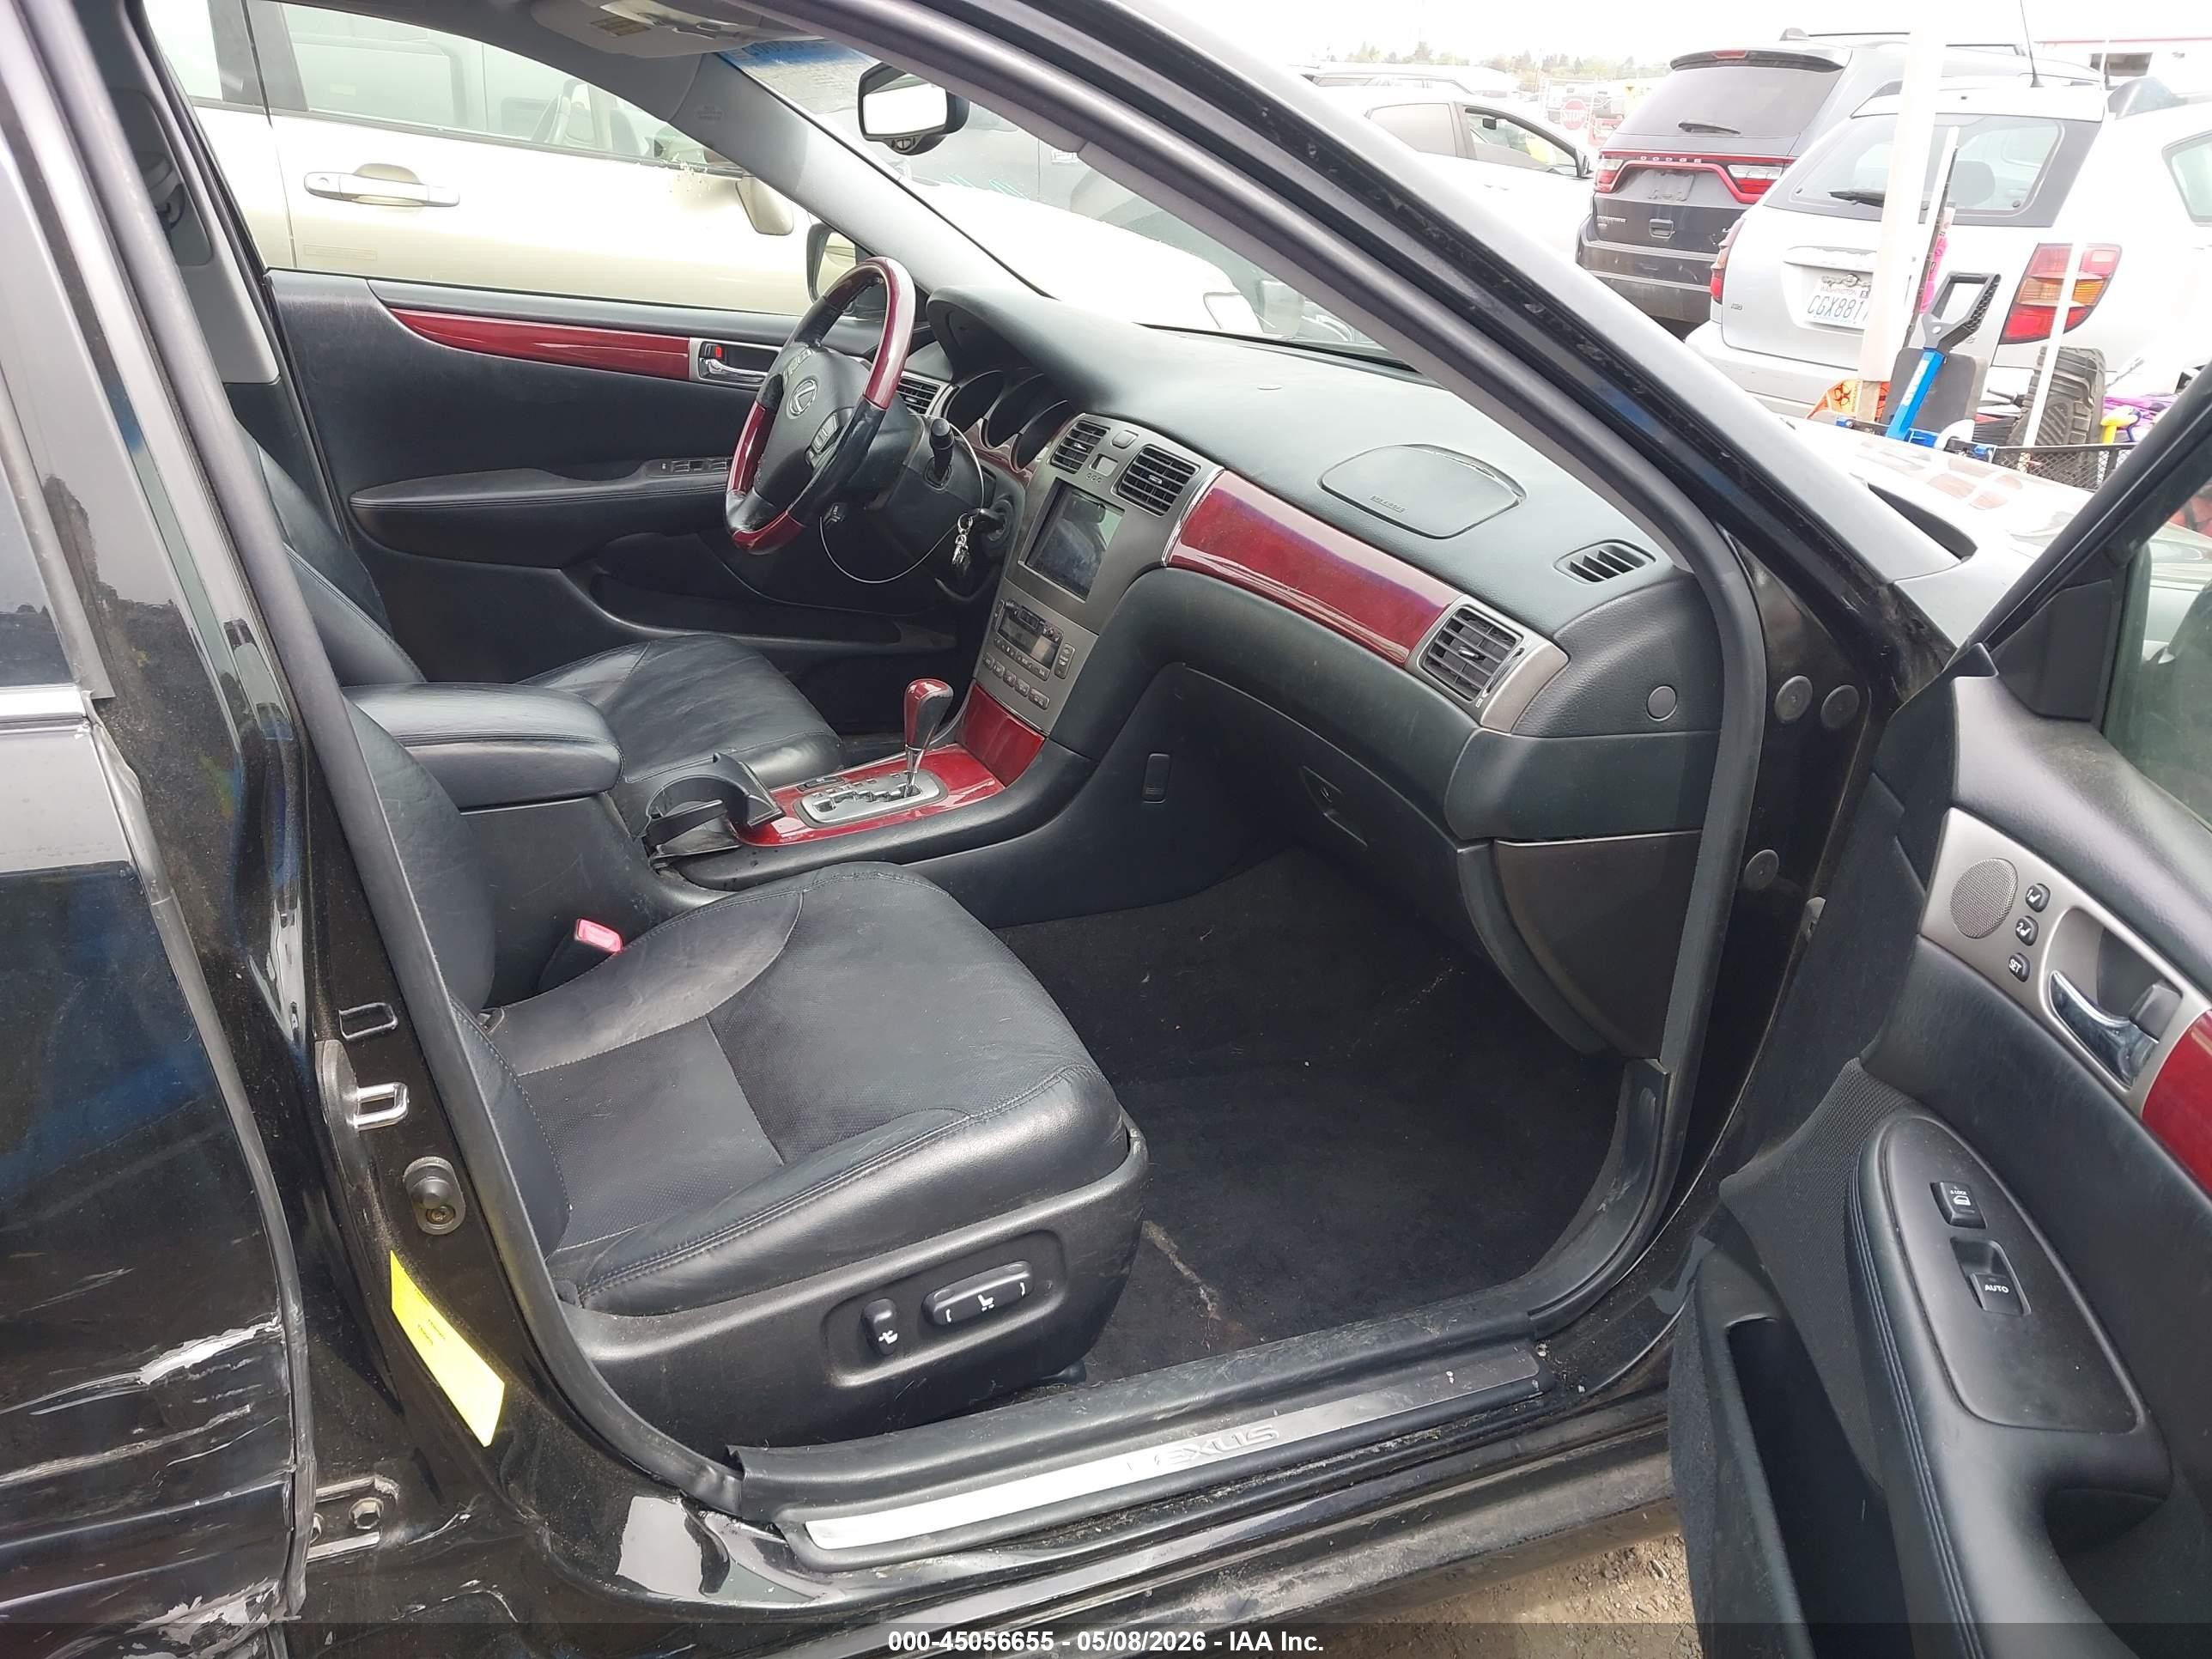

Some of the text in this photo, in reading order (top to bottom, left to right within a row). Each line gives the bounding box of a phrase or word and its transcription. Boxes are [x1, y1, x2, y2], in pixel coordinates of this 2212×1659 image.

[1563, 109, 1586, 121] STOP
[1640, 155, 1702, 164] DODGE
[2008, 958, 2022, 973] SET
[1984, 1284, 2009, 1293] AUTO
